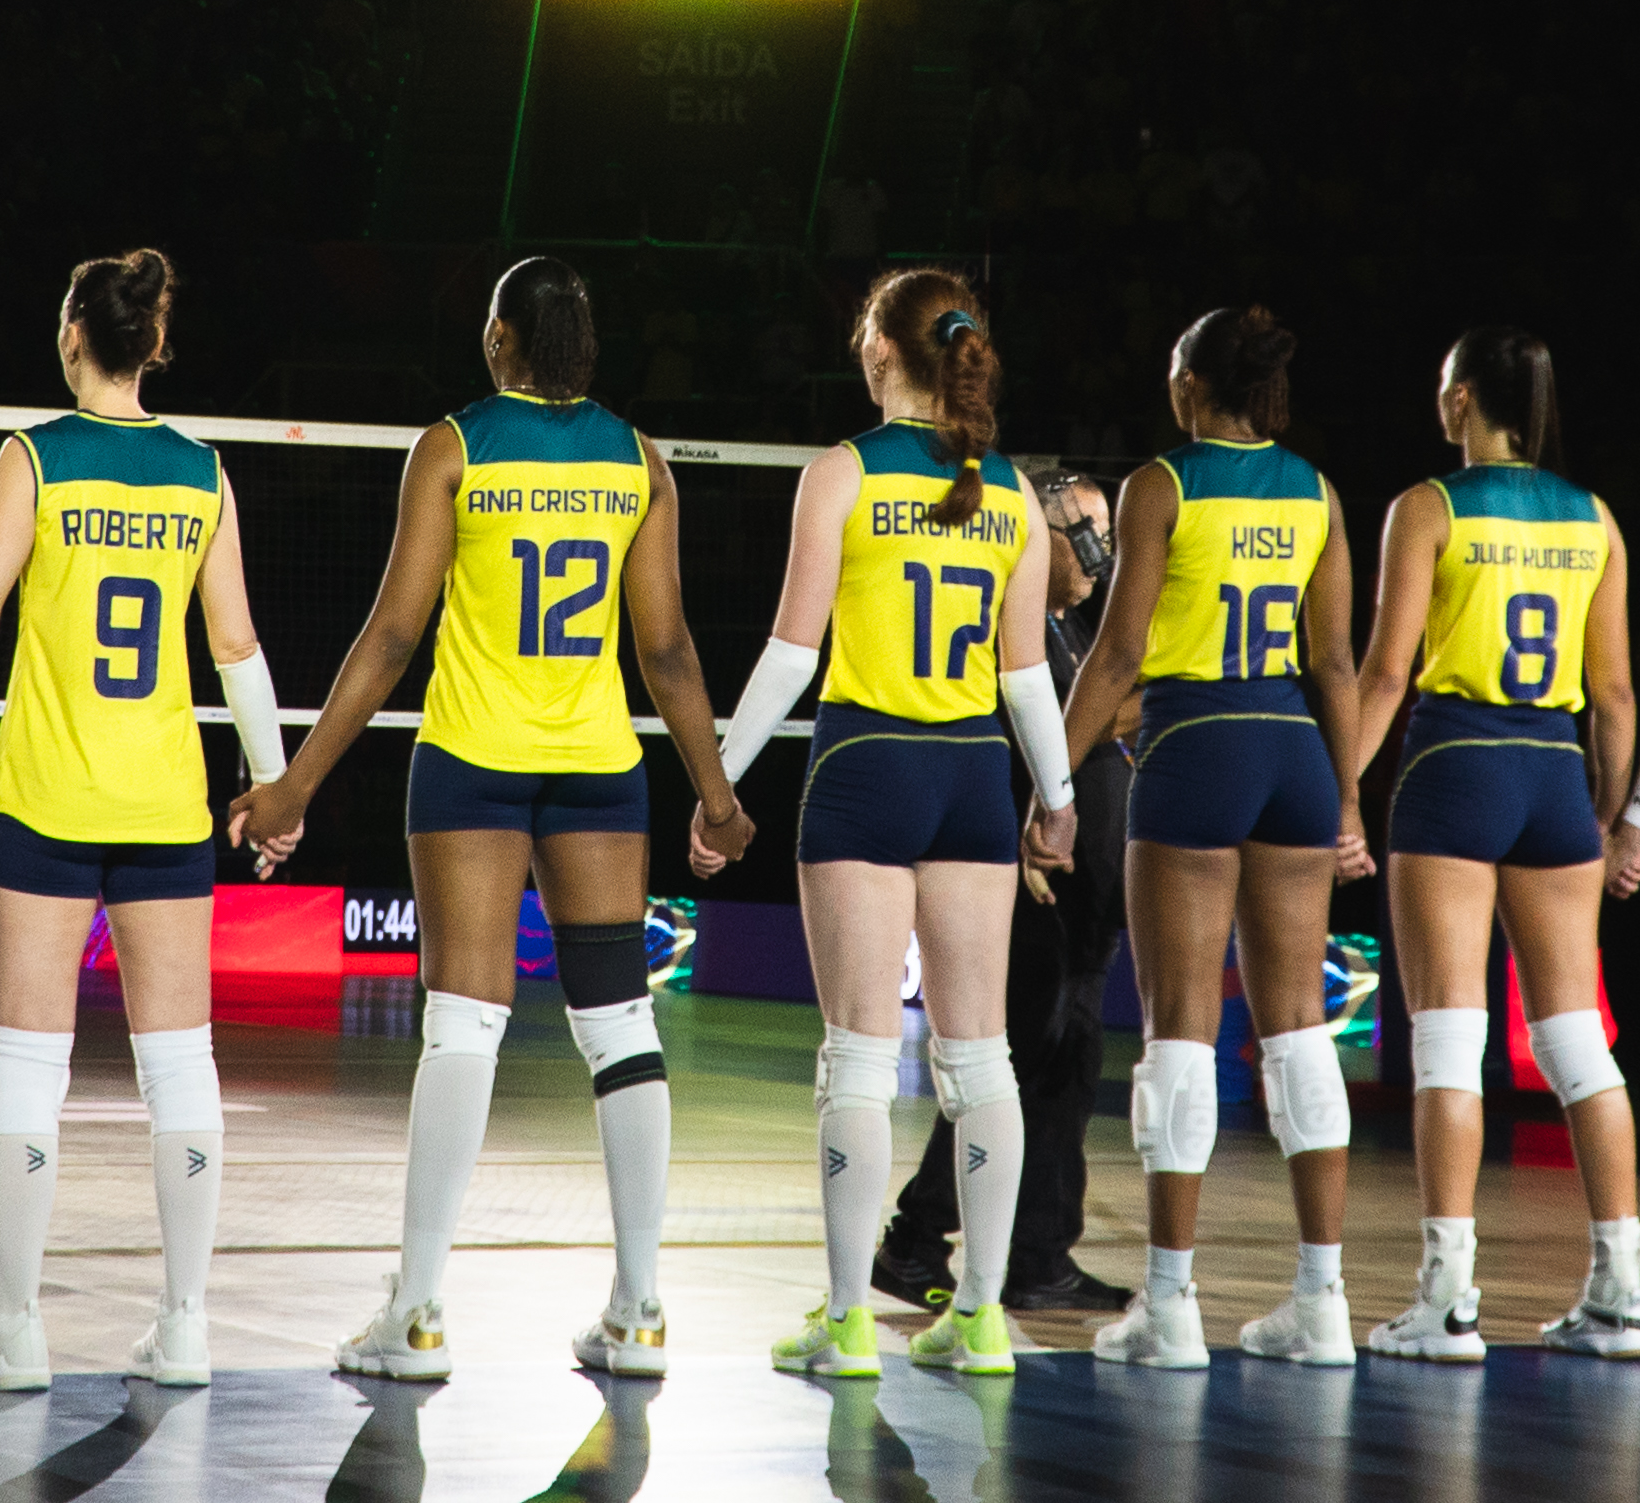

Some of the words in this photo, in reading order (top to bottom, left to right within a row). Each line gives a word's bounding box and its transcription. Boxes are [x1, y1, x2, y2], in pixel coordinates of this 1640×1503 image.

[667, 85, 747, 124] Exit
[61, 508, 203, 555] ROBERTA
[468, 489, 522, 513] ANA
[531, 489, 639, 517] CRISTINA
[1232, 526, 1295, 559] KISY
[512, 538, 609, 657] 12
[904, 561, 995, 680] 17
[1219, 583, 1300, 679] 16
[94, 576, 163, 700] 9
[1500, 593, 1559, 699] 8
[344, 898, 417, 942] 01:44
